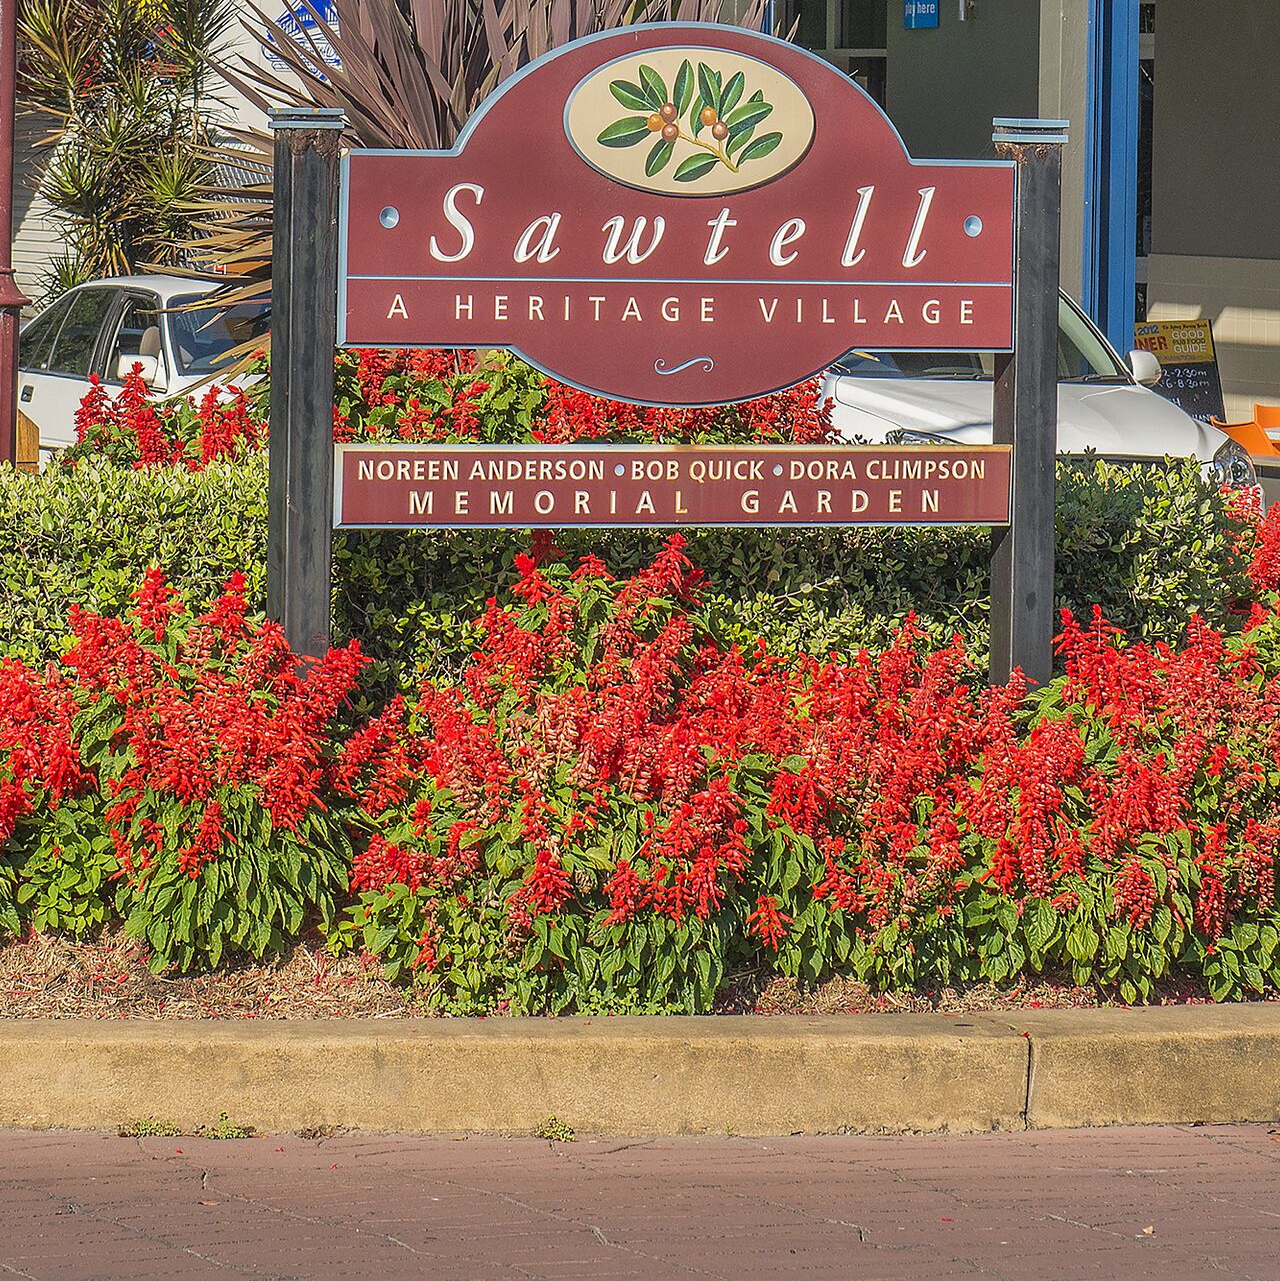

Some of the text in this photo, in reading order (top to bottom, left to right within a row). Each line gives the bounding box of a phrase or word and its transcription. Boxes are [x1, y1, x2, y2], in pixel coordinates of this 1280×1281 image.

[917, 2, 935, 14] here
[428, 182, 937, 269] Sawtell
[387, 294, 976, 325] A HERITAGE VILLAGE
[1137, 324, 1160, 336] 2012
[1171, 330, 1205, 340] GOOD
[1173, 344, 1208, 353] GUIDE
[357, 459, 987, 484] NOREEN ANDERSON BOB QUICK DORA CLIMPSON
[408, 489, 941, 515] MEMORIAL GARDEN
